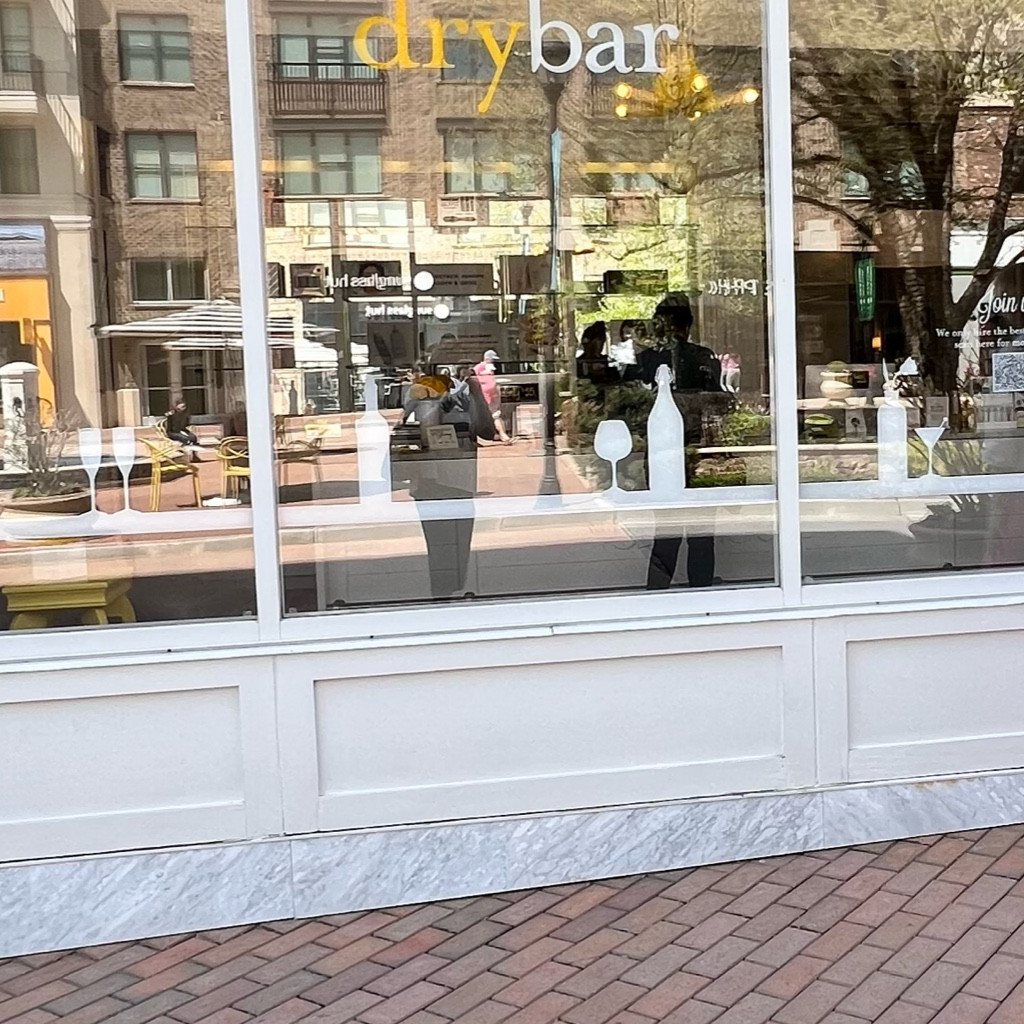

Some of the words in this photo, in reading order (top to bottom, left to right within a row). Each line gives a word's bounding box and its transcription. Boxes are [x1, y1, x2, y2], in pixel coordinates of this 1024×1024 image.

[977, 284, 1018, 324] Join
[935, 328, 950, 337] We
[993, 326, 1008, 335] the
[997, 338, 1010, 347] for
